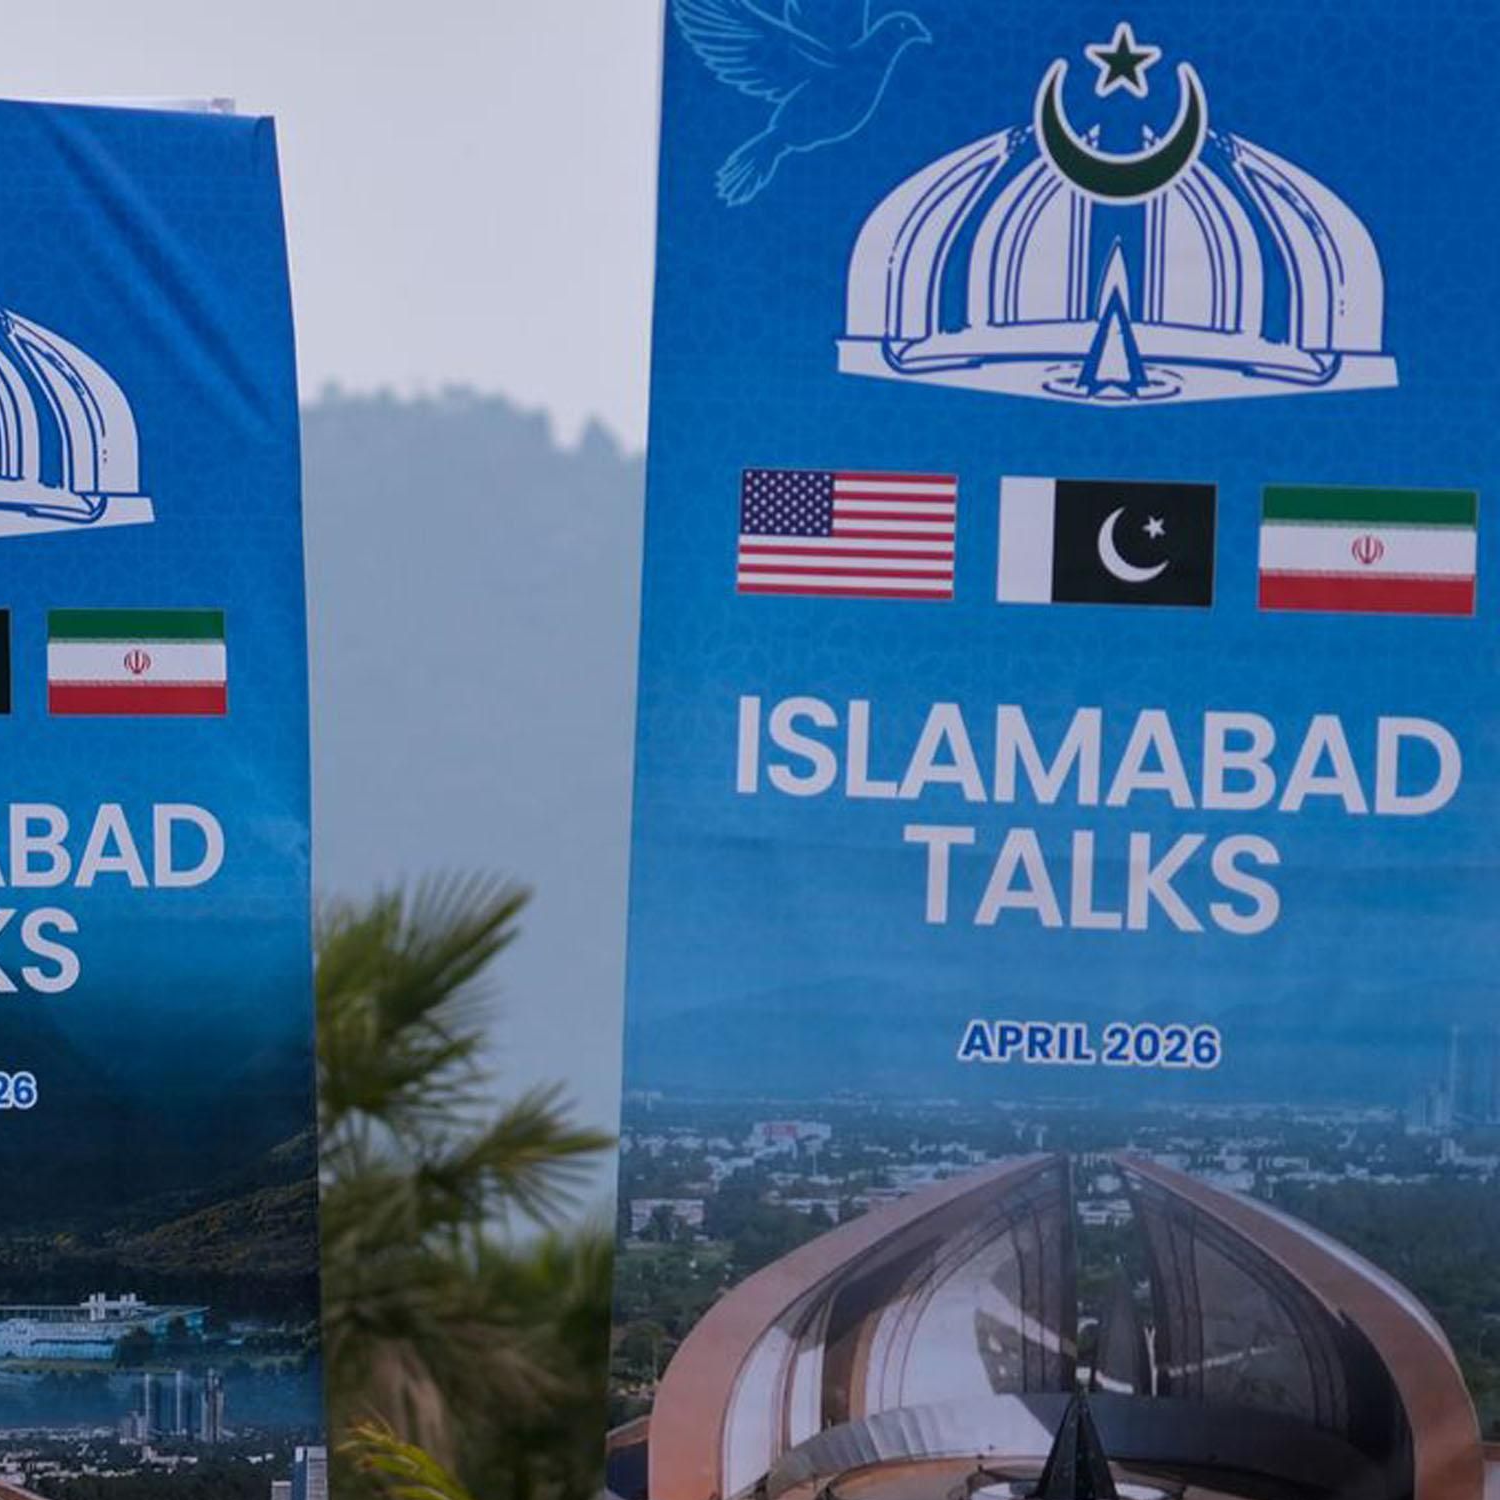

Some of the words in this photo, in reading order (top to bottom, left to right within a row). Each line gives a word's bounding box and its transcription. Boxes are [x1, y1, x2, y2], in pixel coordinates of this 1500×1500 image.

[736, 696, 1463, 816] ISLAMABAD
[903, 824, 1281, 935] TALKS
[957, 1019, 1096, 1064] APRIL
[1102, 1022, 1222, 1069] 2026
